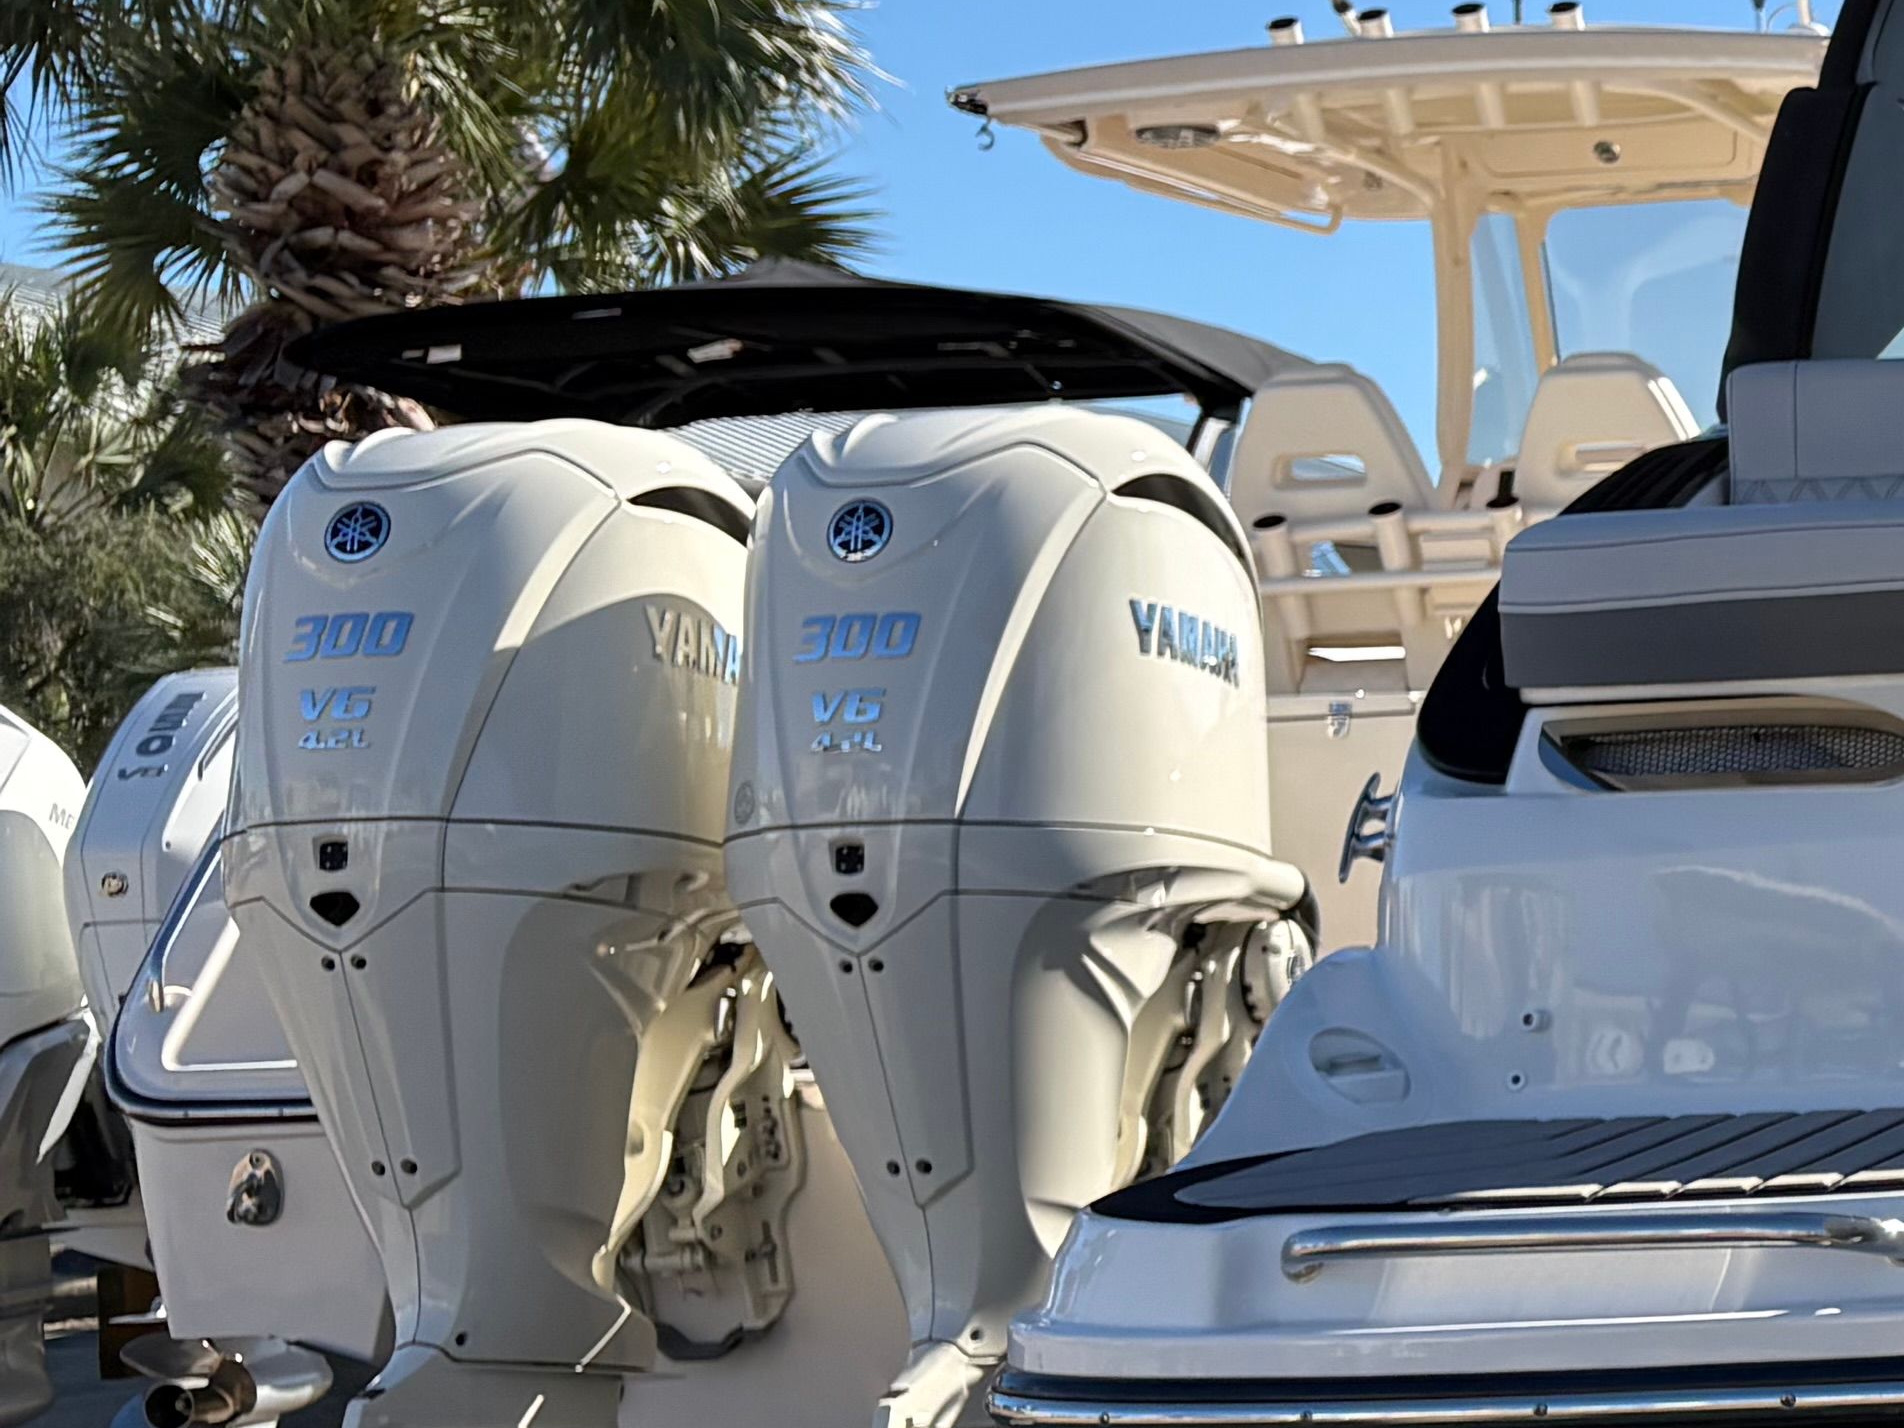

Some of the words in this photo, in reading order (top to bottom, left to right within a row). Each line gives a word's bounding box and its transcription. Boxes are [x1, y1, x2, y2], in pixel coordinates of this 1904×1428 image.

[282, 611, 415, 664] 300
[643, 603, 741, 685] YAMA
[792, 612, 922, 663] 300
[1129, 599, 1239, 689] YAMAHA
[300, 686, 377, 721] V6
[811, 689, 887, 723] V6
